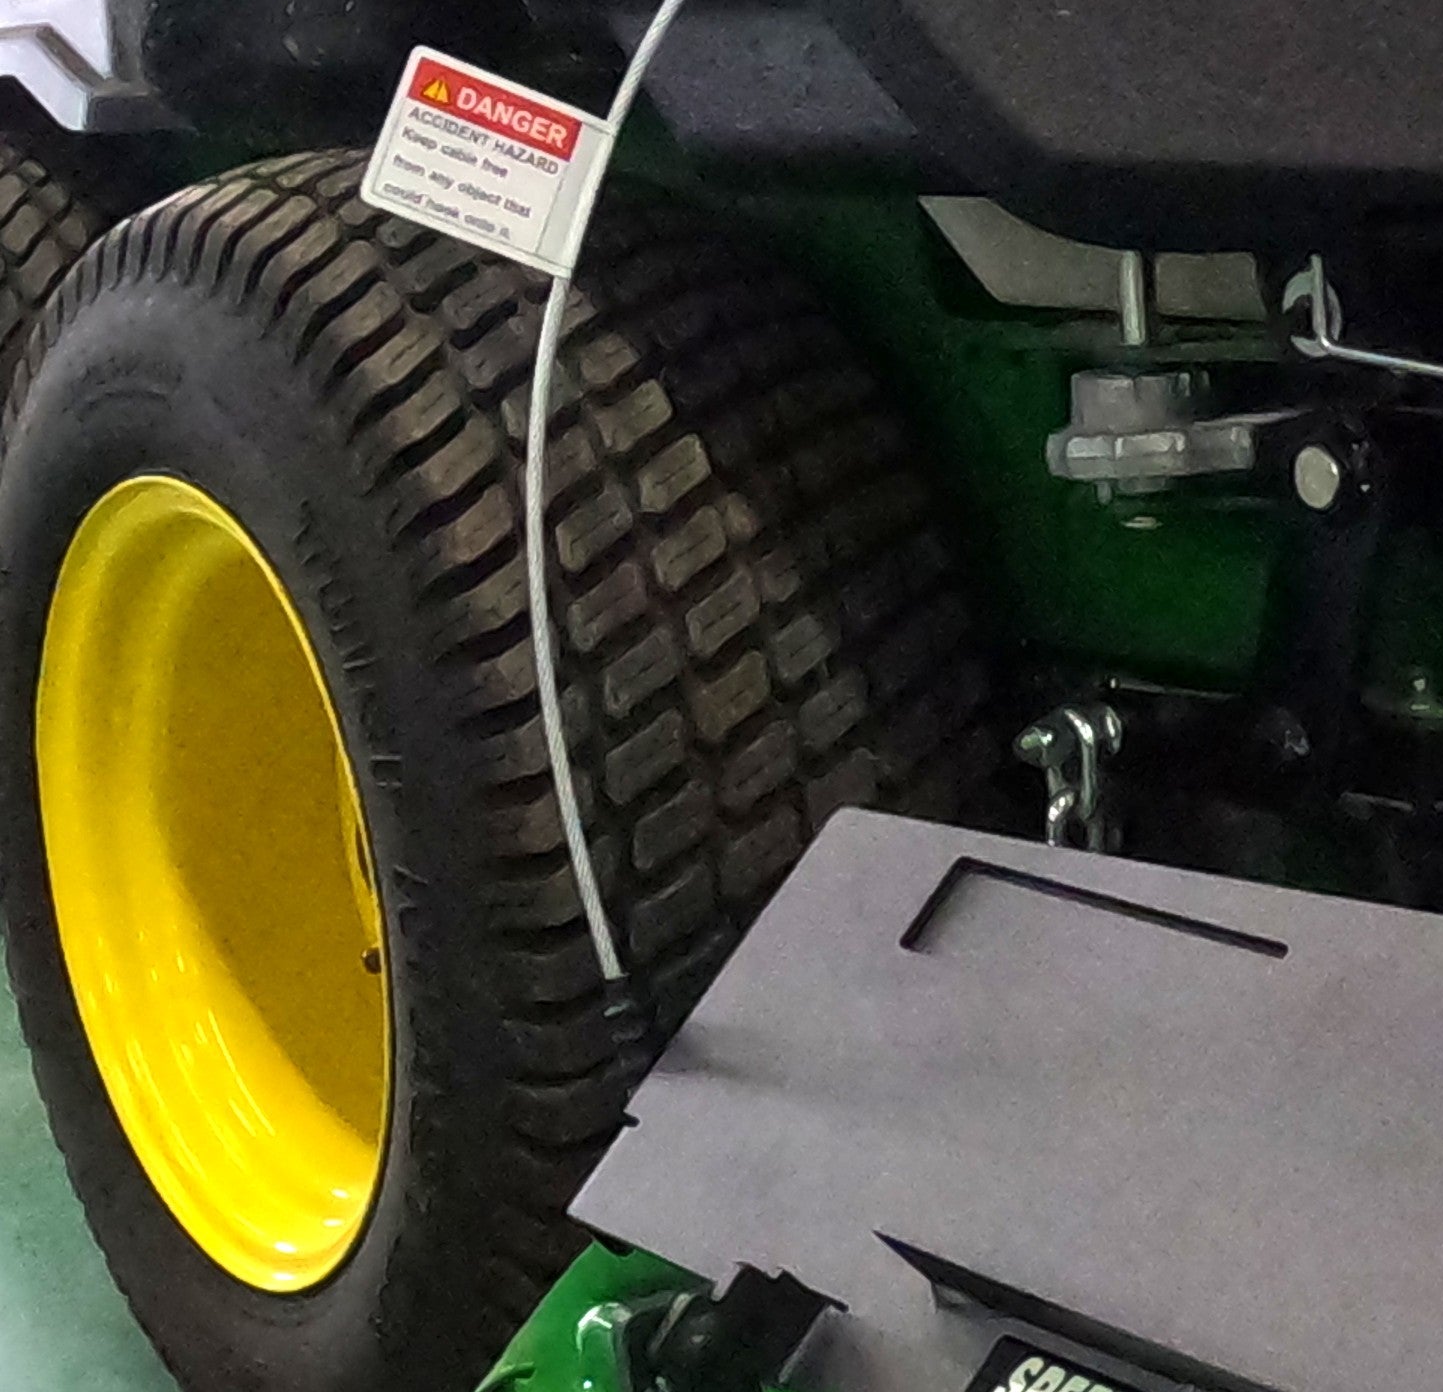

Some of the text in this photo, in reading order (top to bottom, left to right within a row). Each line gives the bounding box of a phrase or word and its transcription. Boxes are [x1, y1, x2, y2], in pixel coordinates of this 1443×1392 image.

[408, 106, 559, 175] ACCIDENT HAZARD
[456, 86, 569, 149] DANGER
[393, 154, 425, 177] from
[428, 168, 455, 191] any
[457, 181, 503, 206] object
[402, 126, 438, 151] Keep
[481, 157, 509, 178] free
